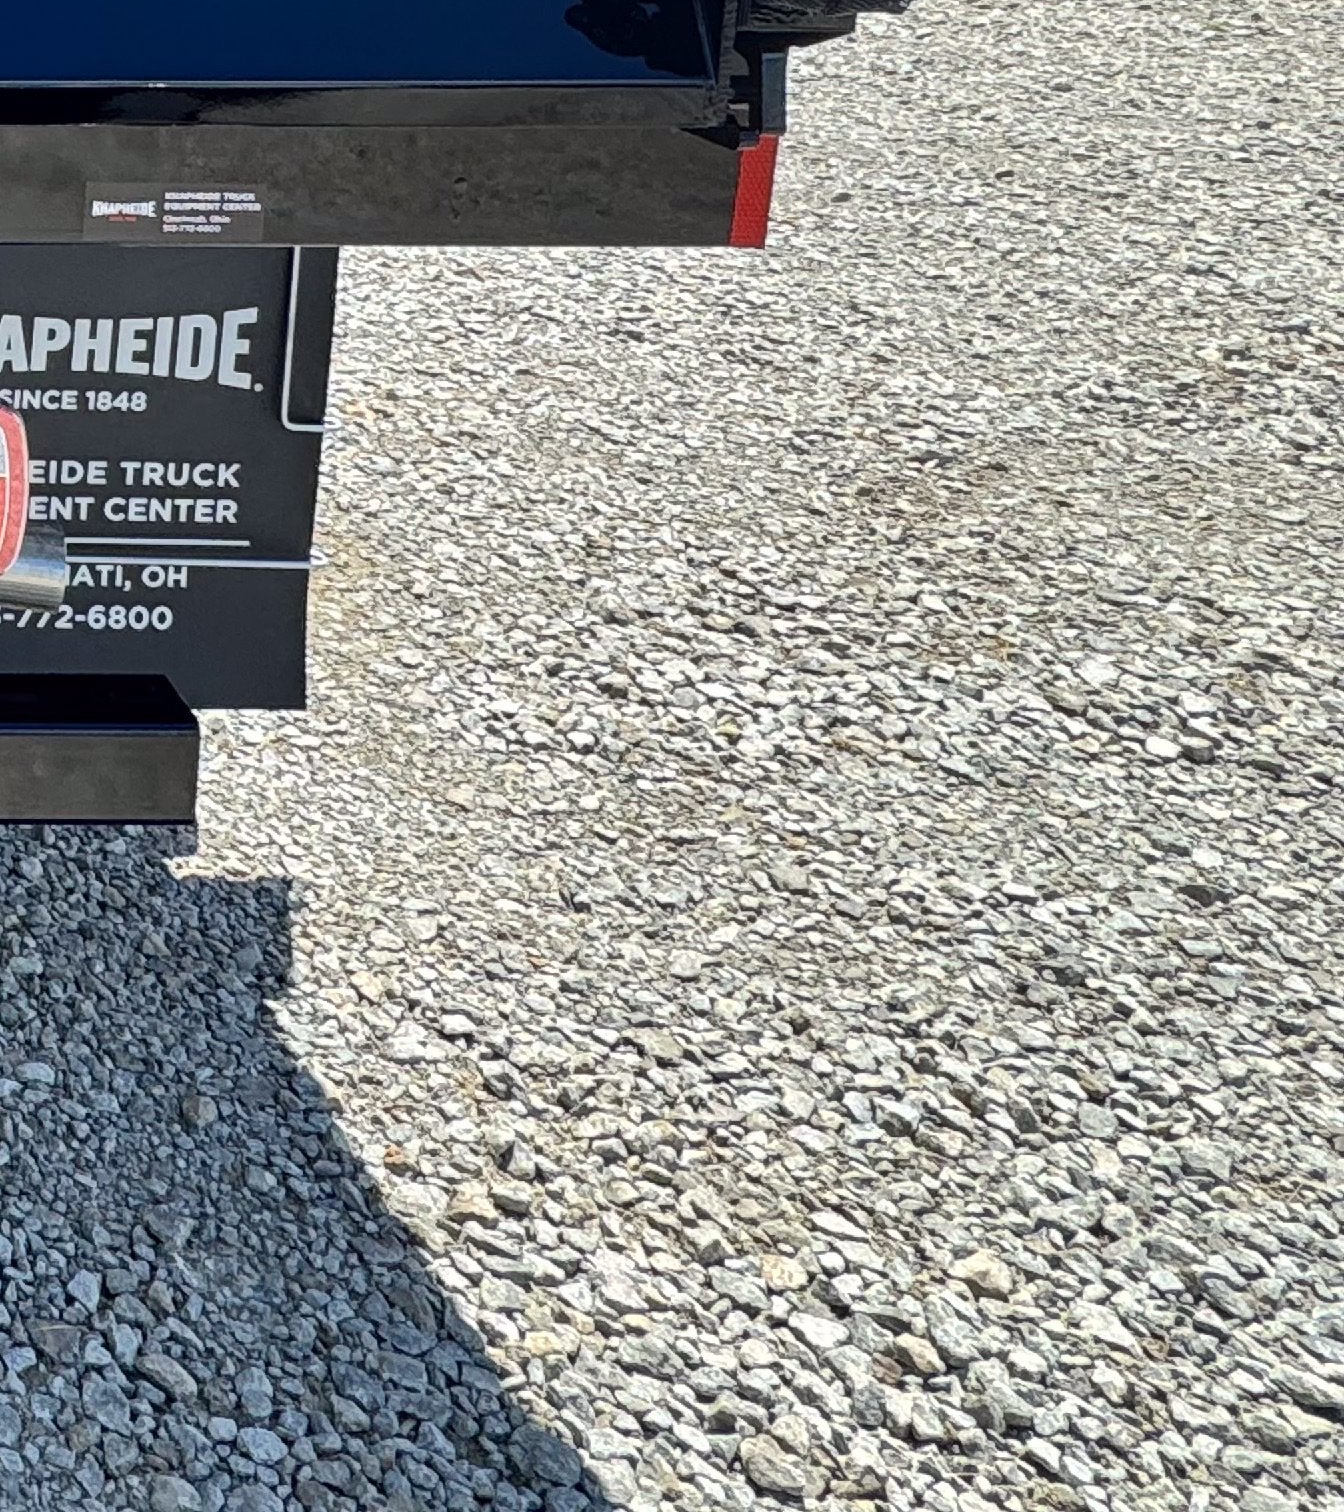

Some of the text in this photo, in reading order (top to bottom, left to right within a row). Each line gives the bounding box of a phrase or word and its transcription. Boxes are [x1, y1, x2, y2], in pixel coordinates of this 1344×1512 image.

[85, 390, 148, 412] 1848
[120, 461, 241, 489] TRUCK
[103, 496, 238, 524] CENTER
[141, 565, 188, 589] OH
